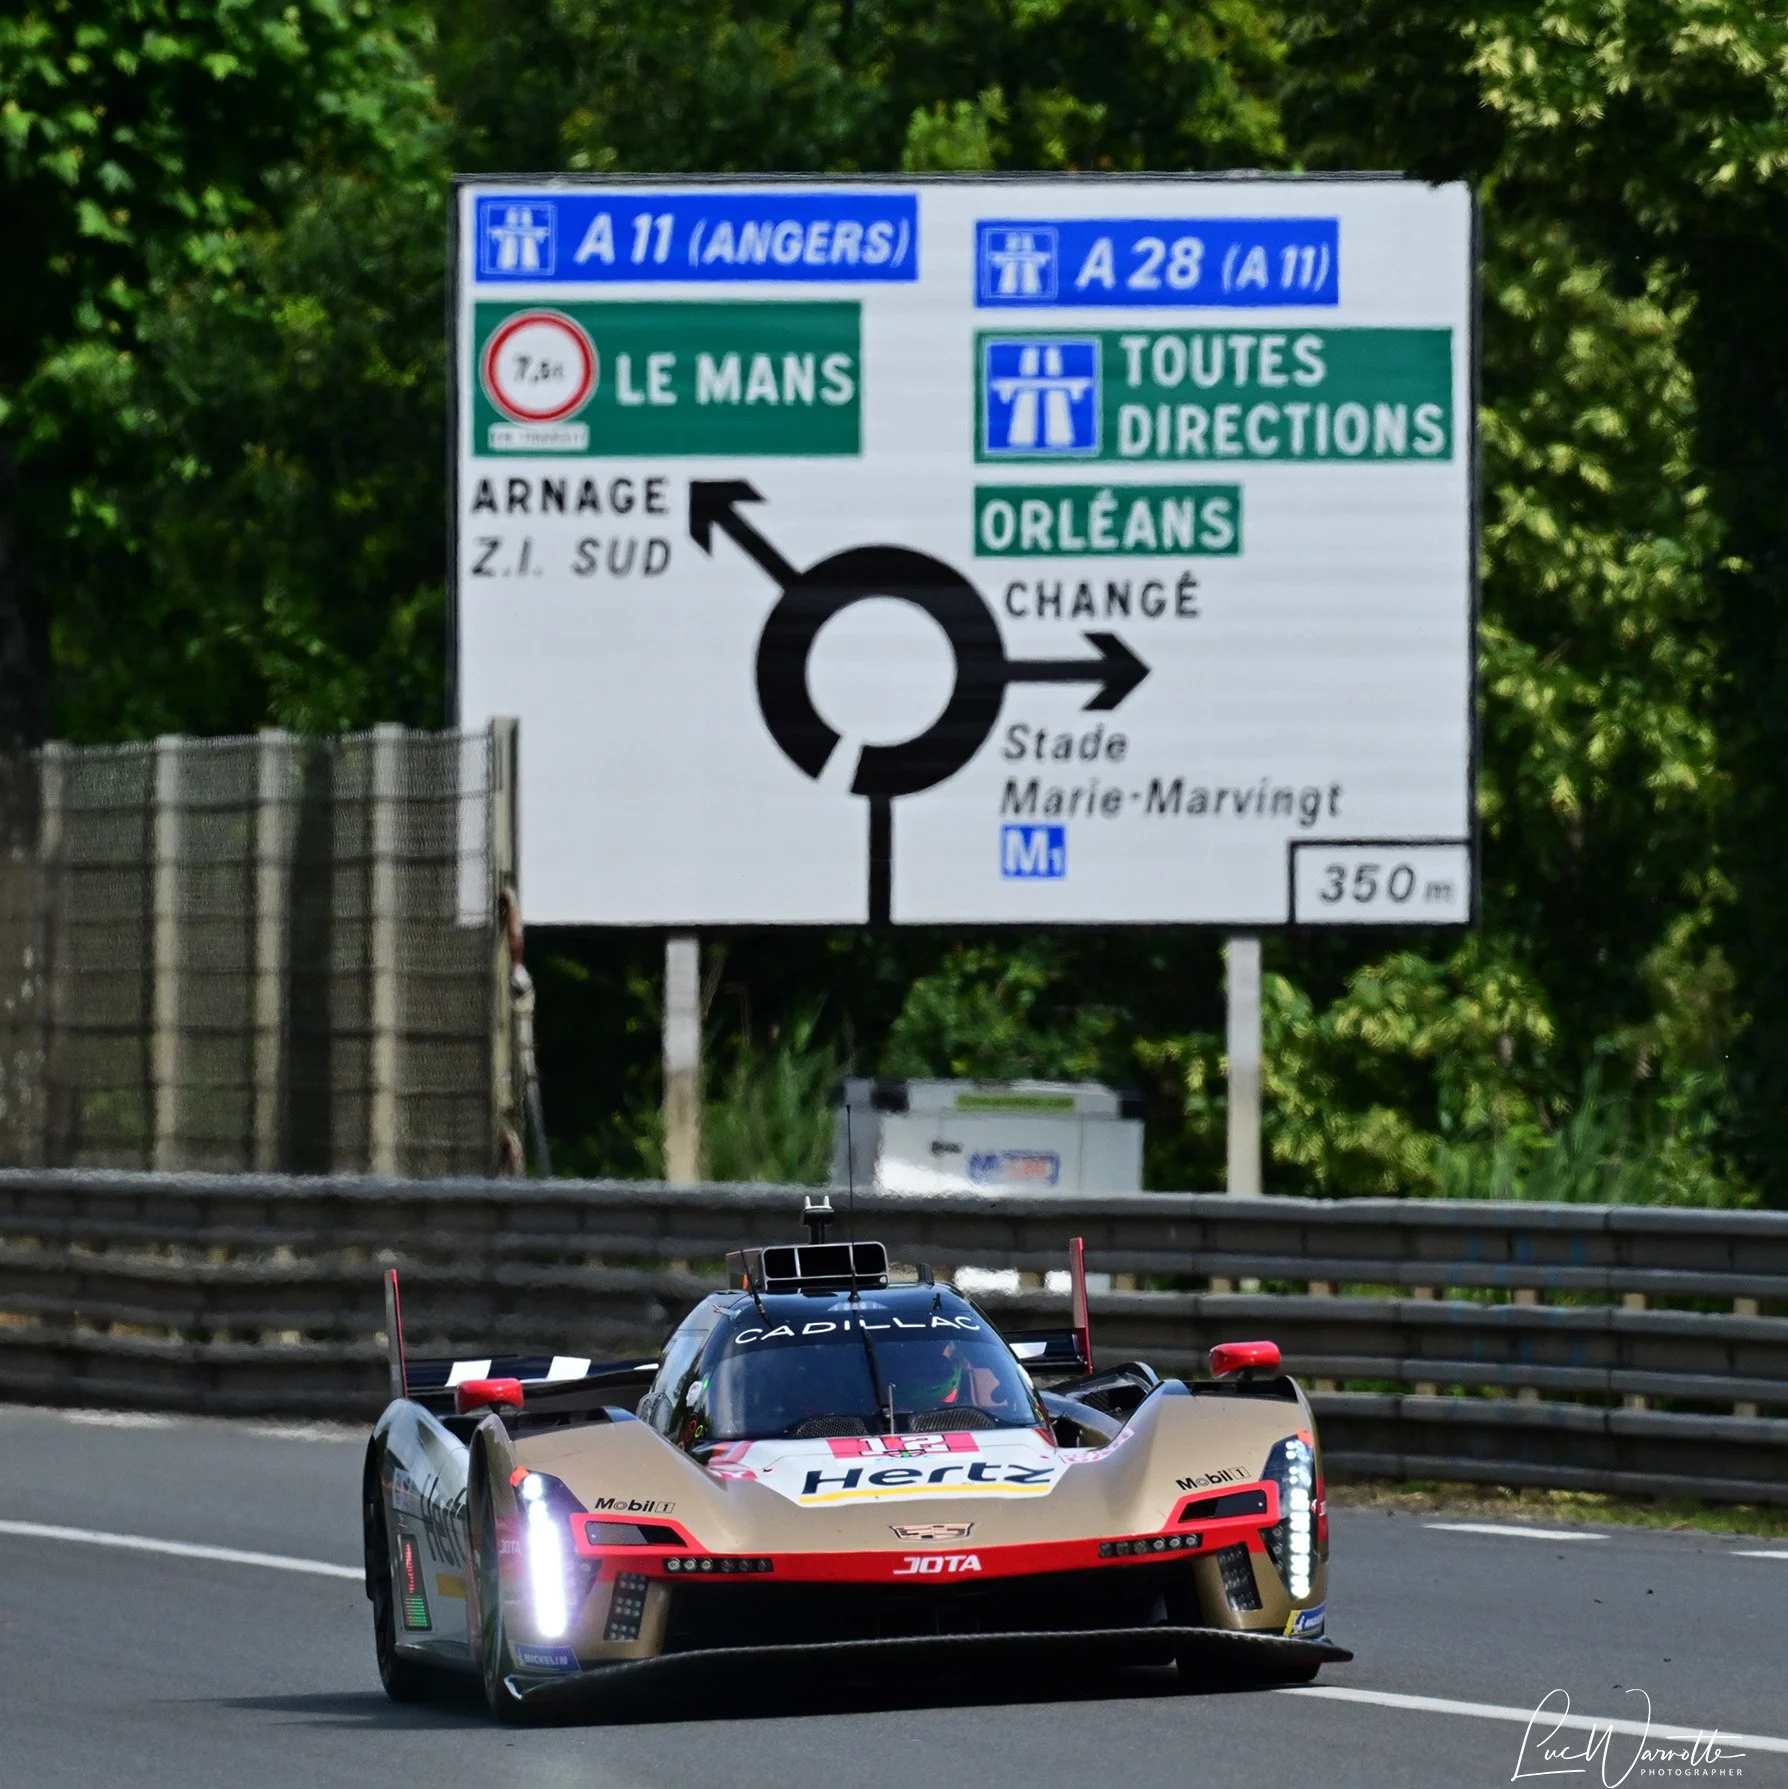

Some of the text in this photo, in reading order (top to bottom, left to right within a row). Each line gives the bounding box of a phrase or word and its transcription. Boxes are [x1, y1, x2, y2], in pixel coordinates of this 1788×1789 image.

[574, 212, 911, 268] A 11 (ANGERS)
[1075, 236, 1332, 294] A 28 (A 11)
[615, 352, 856, 407] LE MANS
[1118, 334, 1328, 388] TOUTES
[1118, 402, 1446, 457] DIRECTIONS
[470, 477, 671, 516] ARNAGE
[980, 488, 1236, 551] ORLÉANS
[471, 536, 673, 578] Z.I. SUD
[1004, 570, 1202, 620] CHANGÉ
[1002, 722, 1130, 762] Stade
[1000, 776, 1343, 829] Marie-Marvingt
[1318, 863, 1455, 904] 350 m
[735, 1315, 980, 1344] CADILLAC
[857, 1433, 949, 1457] 12
[801, 1461, 1056, 1495] Hertz
[1175, 1469, 1234, 1491] Mobil
[595, 1497, 653, 1513] Mobil
[893, 1554, 982, 1575] JOTA
